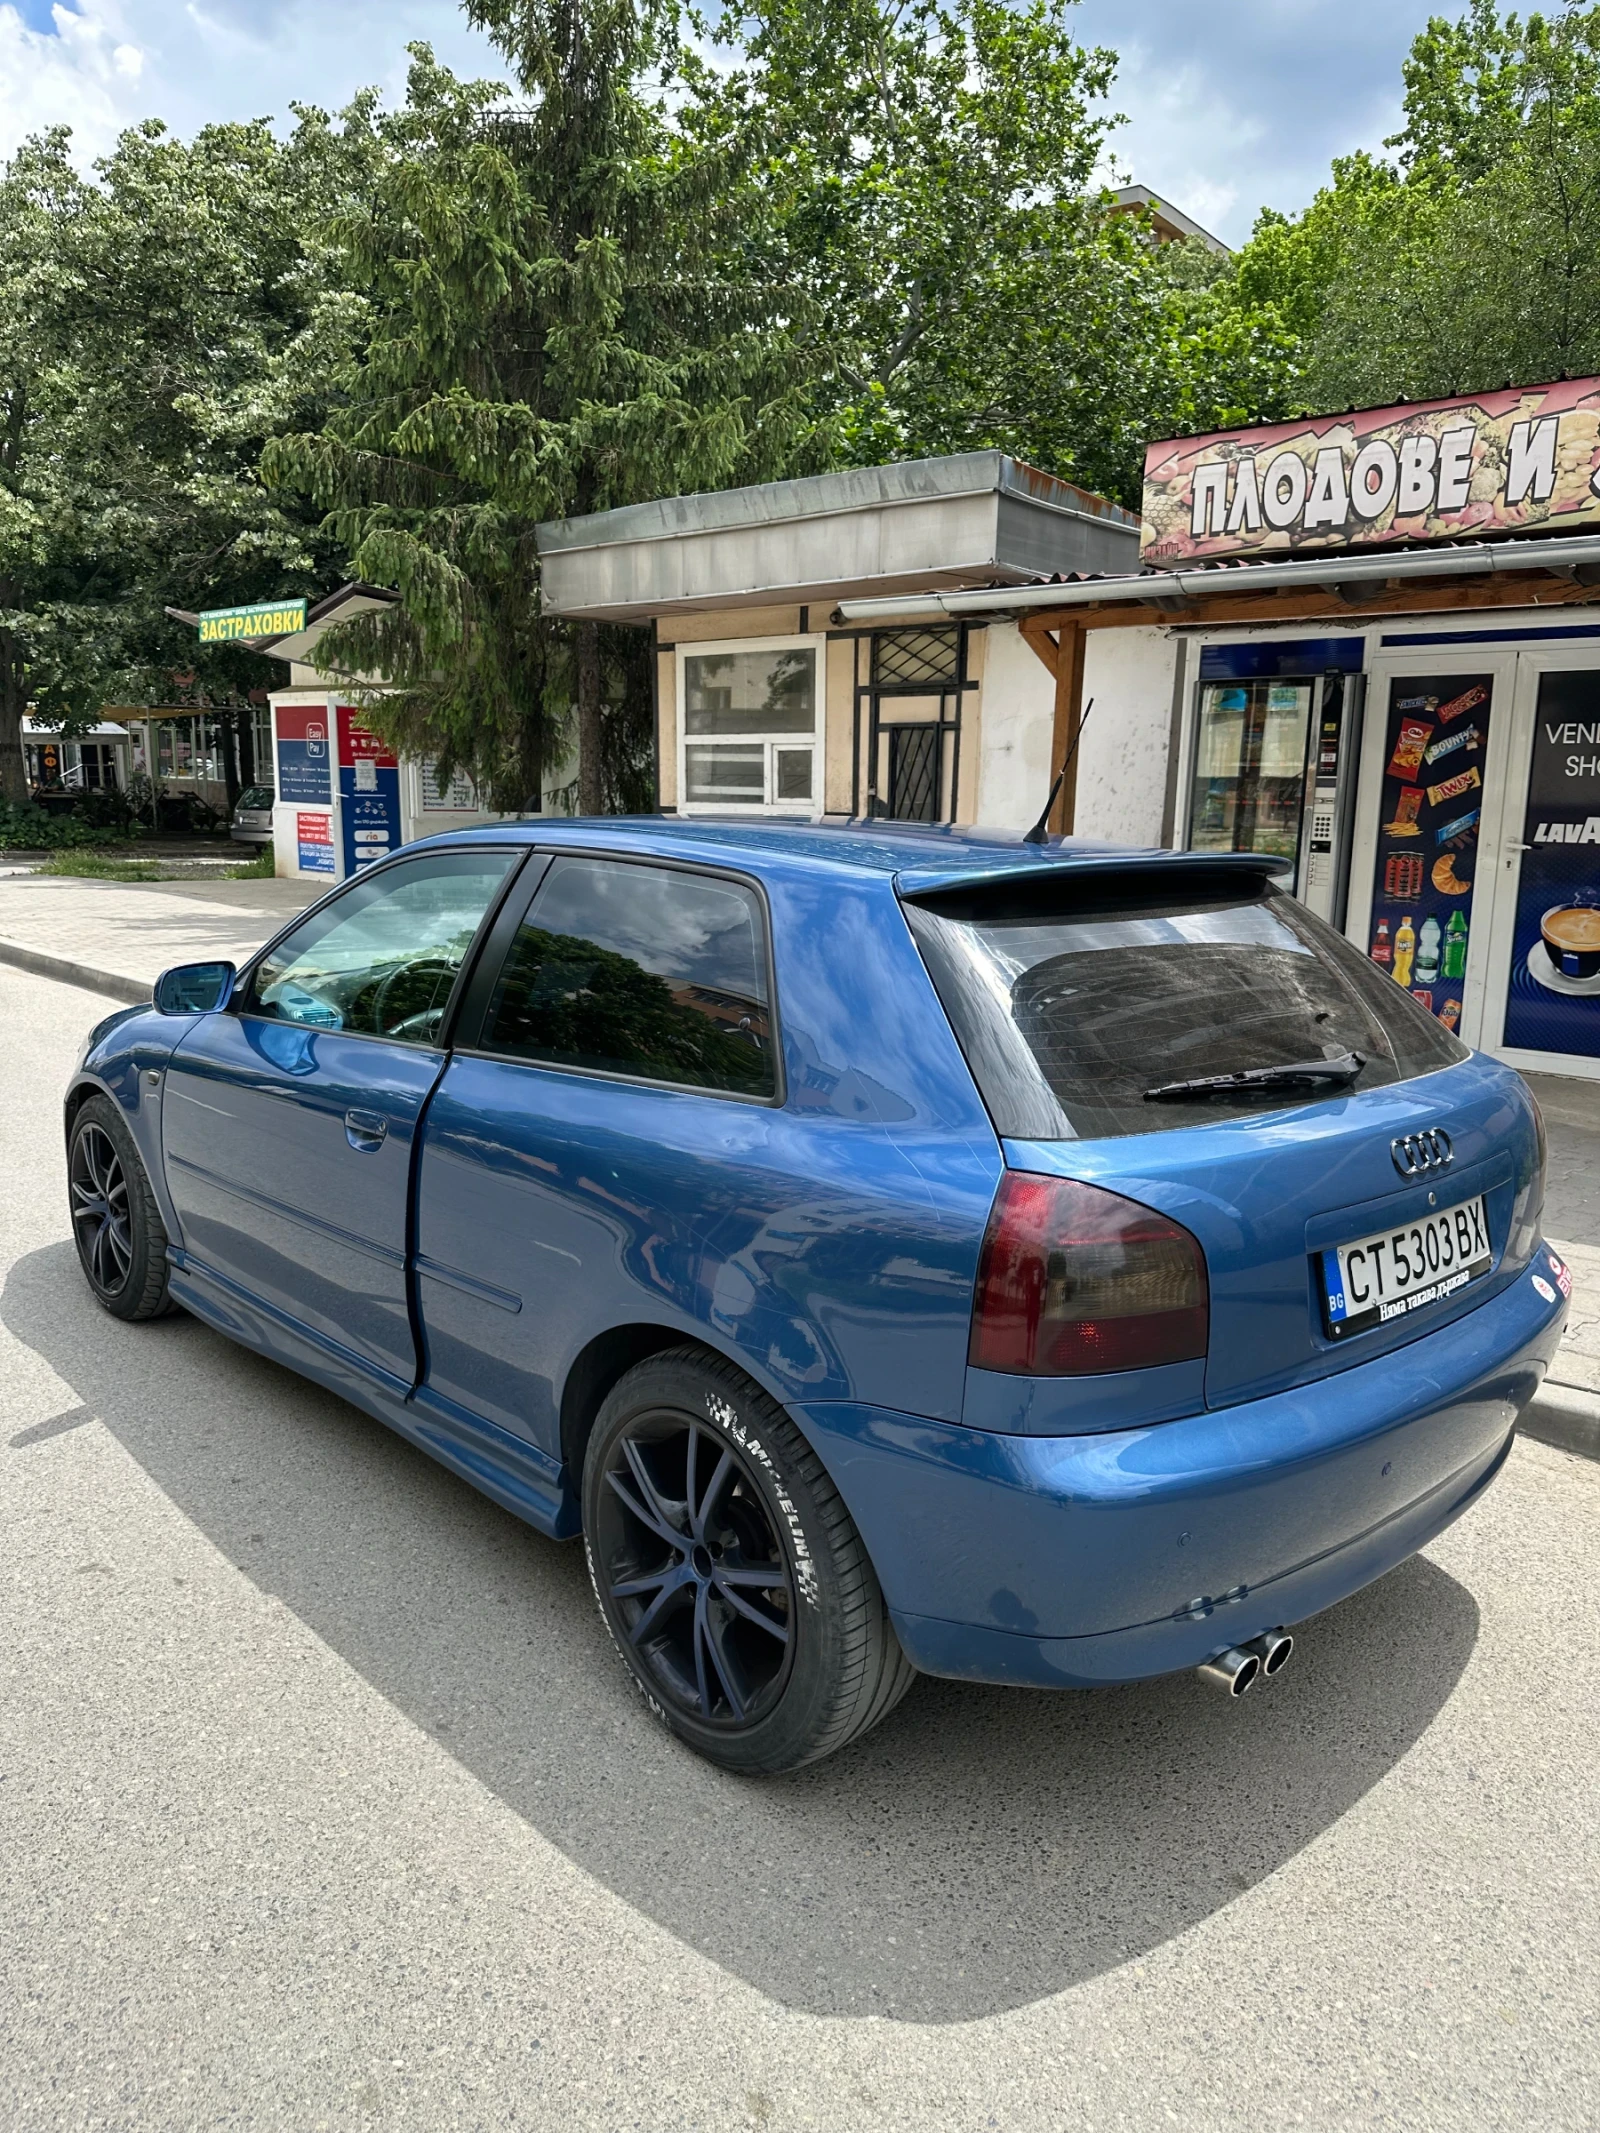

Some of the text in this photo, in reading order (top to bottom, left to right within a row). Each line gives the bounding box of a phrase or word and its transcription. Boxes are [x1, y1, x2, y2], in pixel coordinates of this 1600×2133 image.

[1191, 417, 1559, 536] ПЛОДОВЕ И
[200, 609, 304, 641] ЗАСТРАХОВКИ
[308, 728, 323, 740] Easy
[1431, 730, 1470, 756] BOUNTY
[1545, 722, 1600, 744] VEN
[309, 742, 320, 754] Pay
[1564, 755, 1600, 777] SH
[1436, 774, 1470, 797] TWIX
[365, 831, 379, 841] ria
[1533, 816, 1600, 844] LAVA
[1346, 1201, 1486, 1303] CT 5303 BX
[1328, 1293, 1344, 1312] BG
[1379, 1299, 1407, 1322] Няма
[1406, 1286, 1437, 1310] такава
